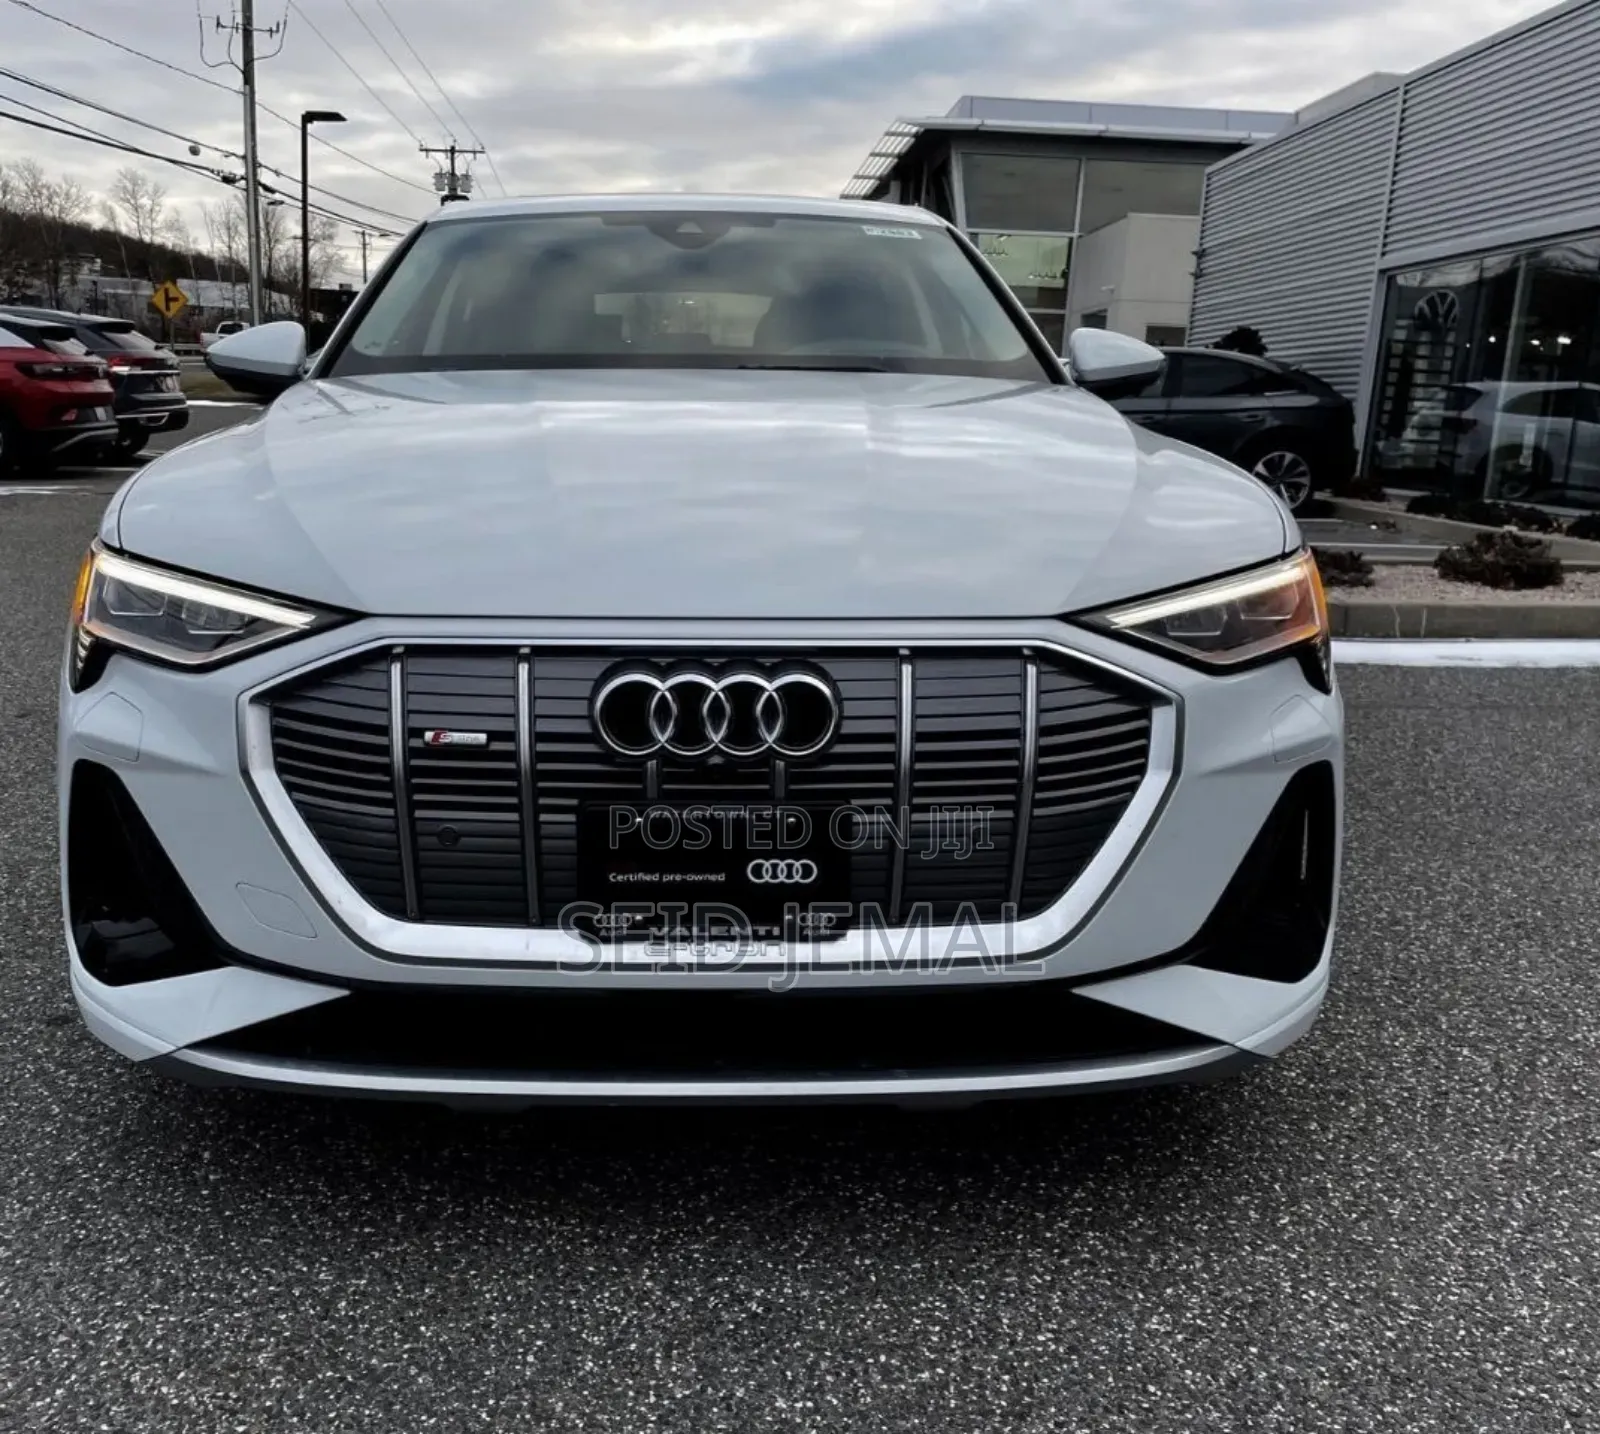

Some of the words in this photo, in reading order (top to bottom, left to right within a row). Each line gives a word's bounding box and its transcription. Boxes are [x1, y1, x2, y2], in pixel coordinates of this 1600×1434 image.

[608, 872, 659, 882] Certified
[662, 873, 725, 883] pre-owned
[649, 926, 781, 936] VALENTI
